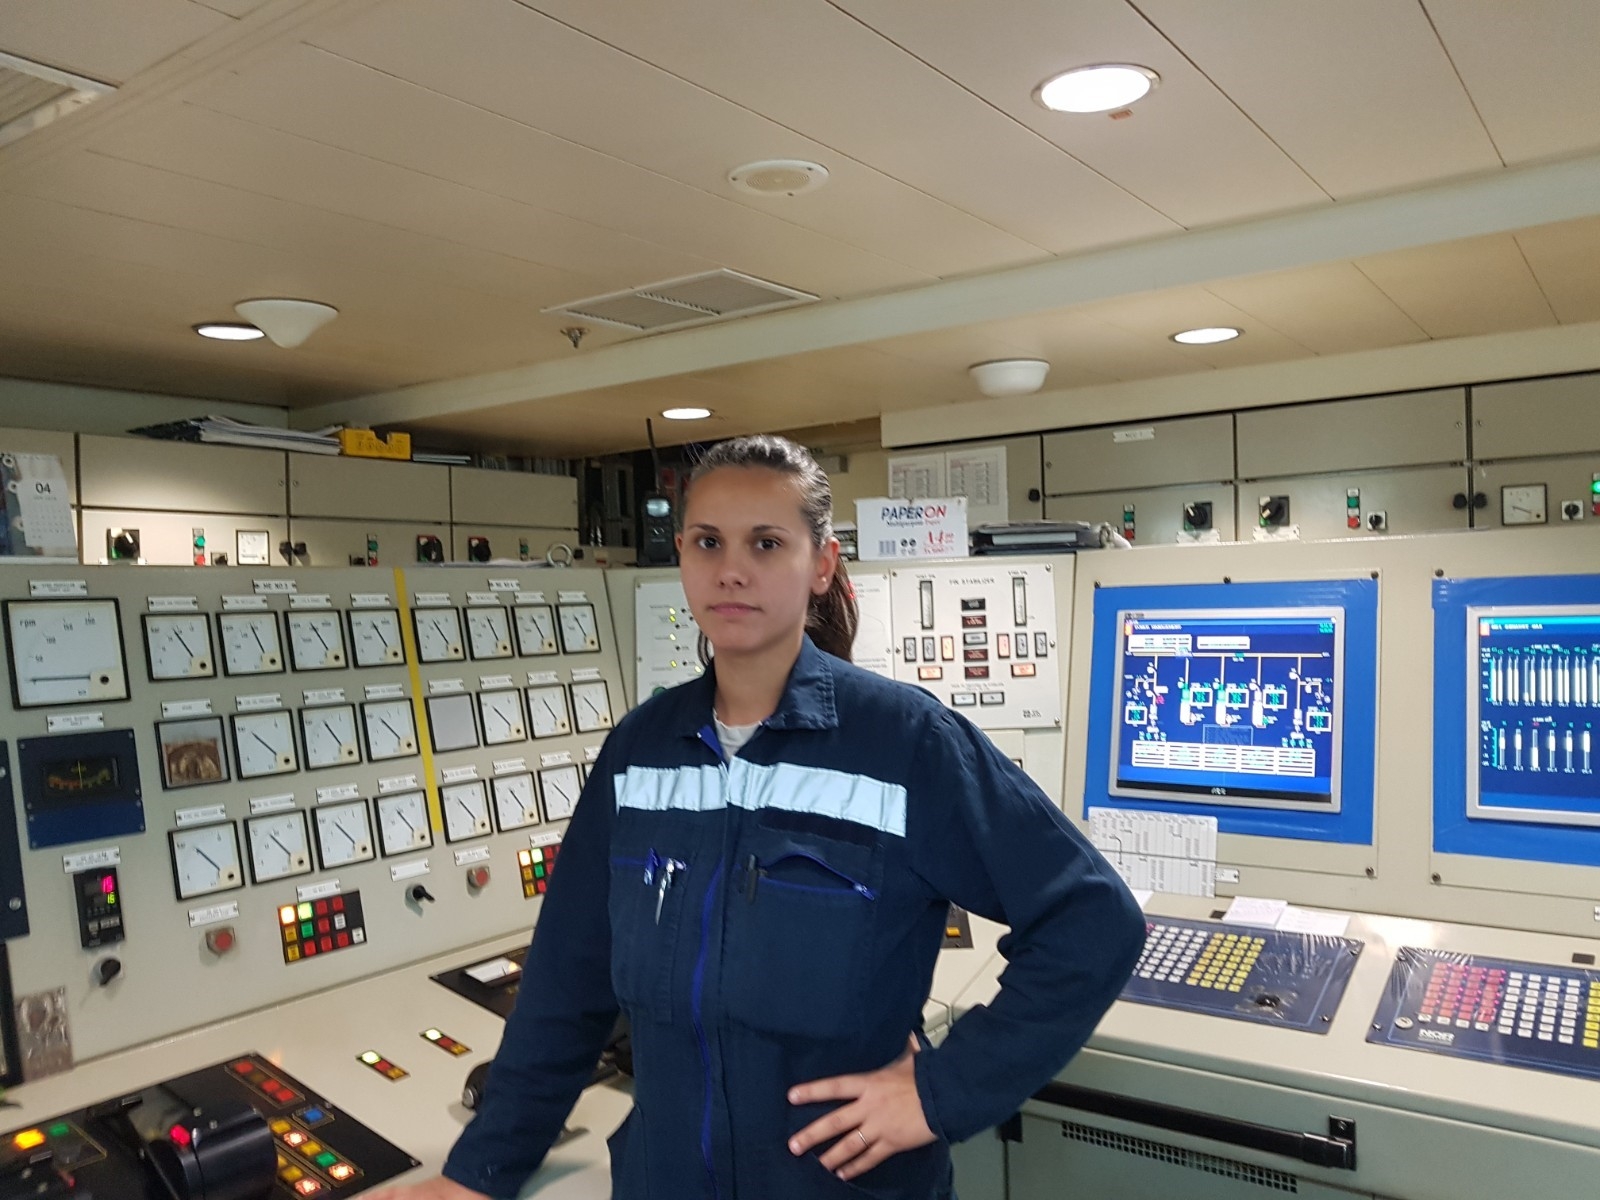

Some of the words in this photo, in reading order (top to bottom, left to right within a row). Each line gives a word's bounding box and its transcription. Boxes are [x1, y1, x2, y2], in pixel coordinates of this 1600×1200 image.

[35, 482, 51, 494] 04
[881, 504, 947, 520] PAPERON
[20, 619, 36, 629] rpm
